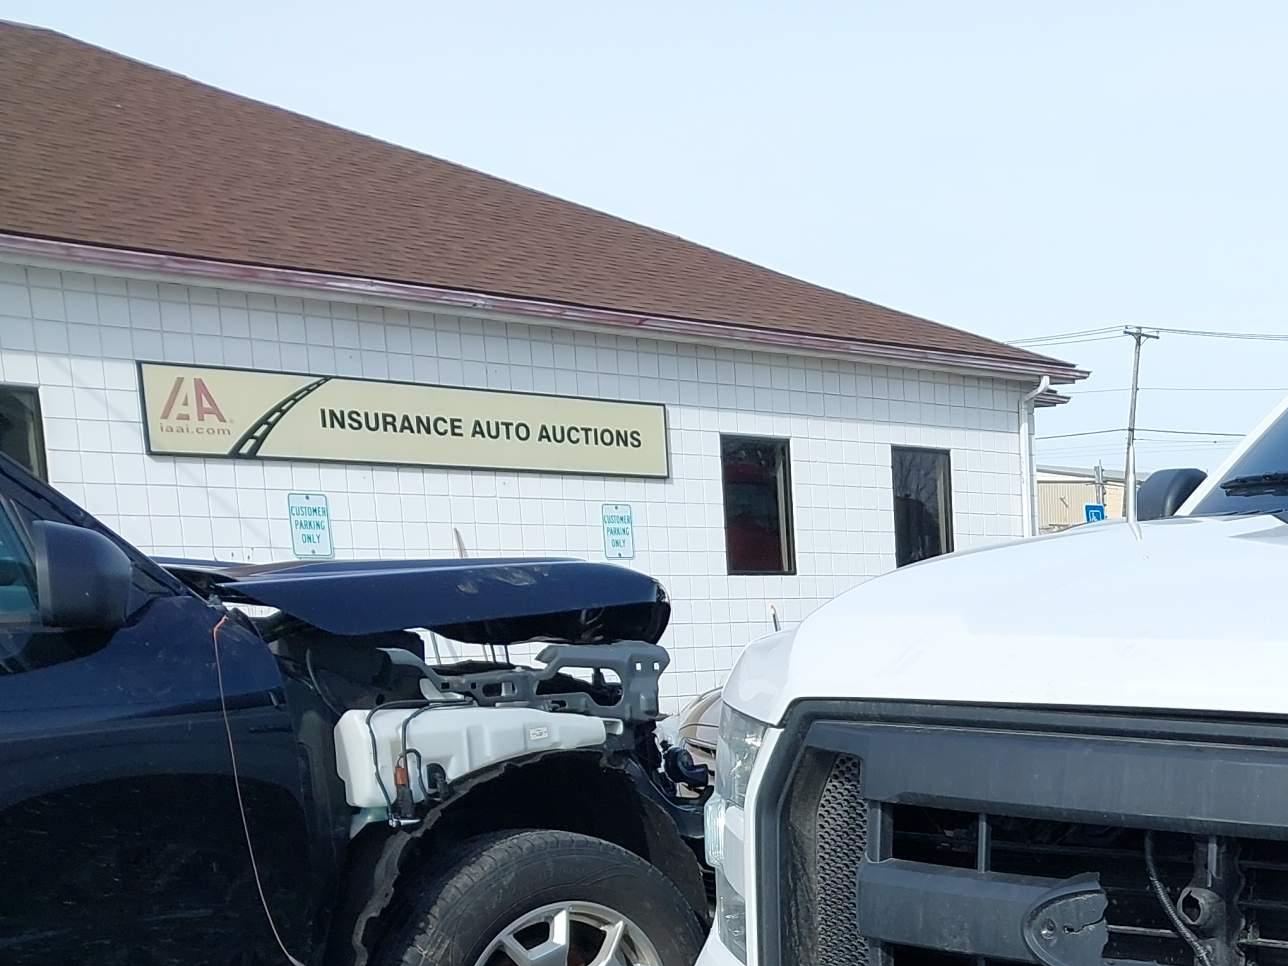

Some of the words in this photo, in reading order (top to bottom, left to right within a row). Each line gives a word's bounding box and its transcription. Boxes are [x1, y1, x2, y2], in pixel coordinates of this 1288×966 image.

[159, 422, 232, 436] iaai.com
[319, 407, 464, 437] INSURANCE
[471, 419, 531, 442] AUTO
[537, 424, 642, 449] AUCTIONS
[290, 505, 327, 516] CUSTOMER
[603, 514, 631, 524] CUSTOMER
[295, 519, 326, 530] PARKING
[606, 526, 630, 536] PARKING
[301, 533, 321, 543] ONLY
[611, 538, 626, 548] ONLY
